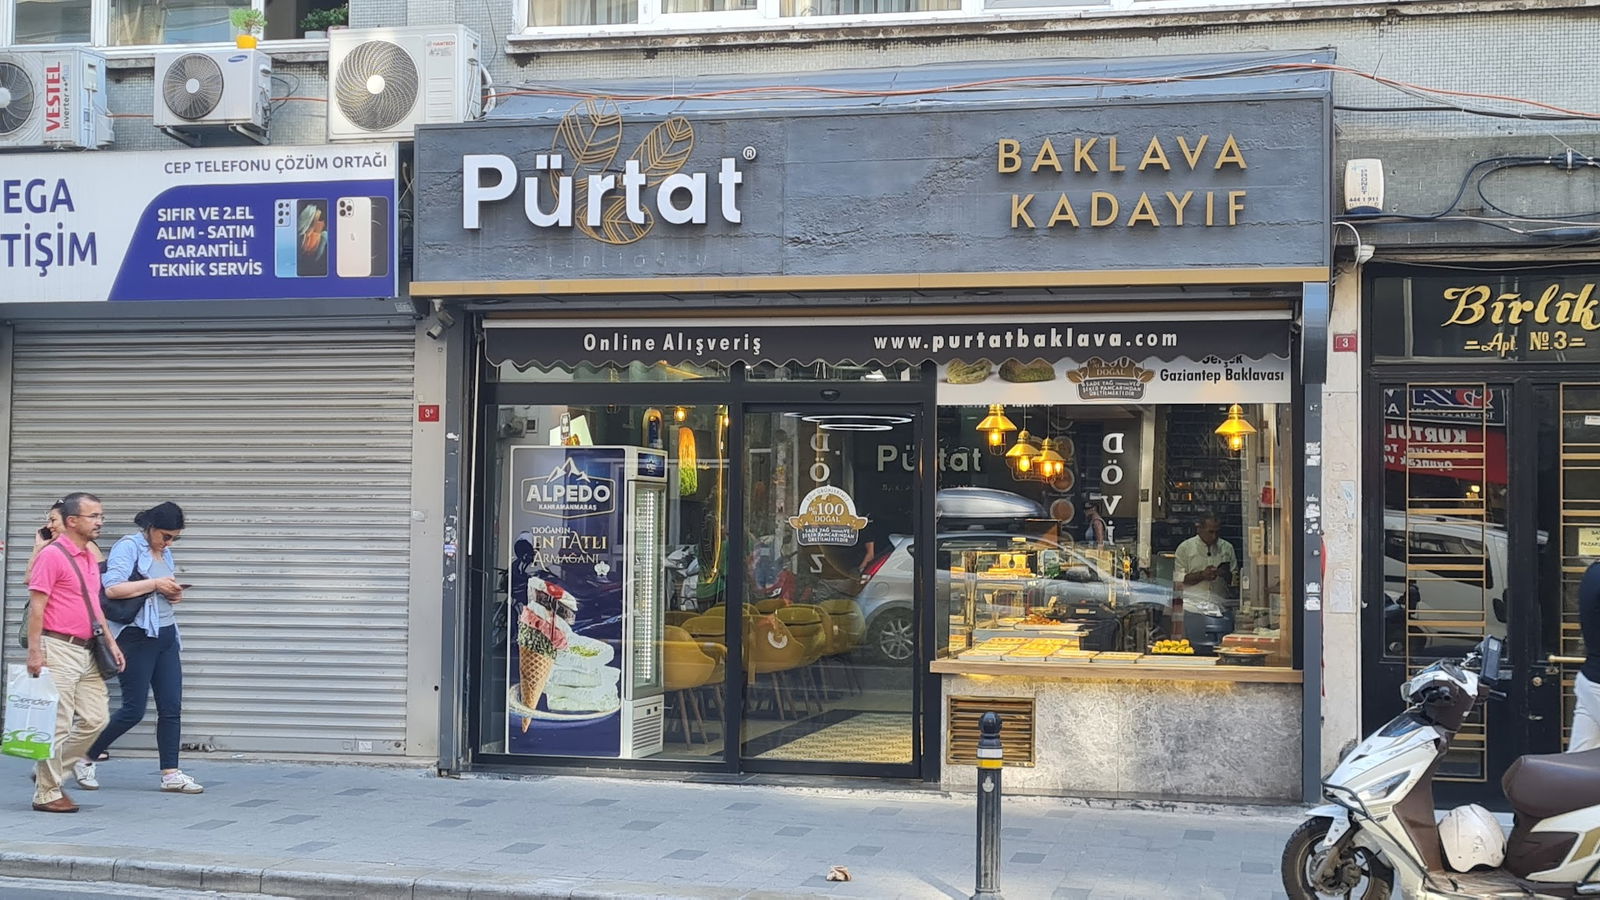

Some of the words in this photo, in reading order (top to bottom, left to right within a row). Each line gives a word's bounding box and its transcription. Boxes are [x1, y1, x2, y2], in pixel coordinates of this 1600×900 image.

[46, 62, 60, 132] VESTEL
[62, 94, 70, 130] inverter
[164, 161, 191, 174] CEP
[195, 159, 271, 173] TELEFONU
[275, 155, 328, 173] ÇÖZÜM
[332, 152, 388, 168] ORTAĞI
[998, 133, 1248, 174] BAKLAVA
[4, 178, 75, 214] EGA
[462, 154, 743, 230] Pürtat
[157, 208, 196, 222] SIFIR
[199, 207, 220, 221] VE
[223, 206, 254, 220] 2.EL
[1011, 190, 1247, 229] KADAYIF
[157, 226, 195, 240] ALIM
[207, 225, 255, 239] SATIM
[0, 222, 97, 277] TİŞİM
[164, 240, 248, 259] GARANTİLİ
[149, 259, 207, 277] TEKNİK
[209, 258, 263, 276] SERVİS
[583, 332, 655, 352] Online
[663, 332, 762, 357] Alışveriş
[874, 327, 1178, 351] www.purtatbaklava.com
[1342, 337, 1349, 348] 3
[1160, 368, 1221, 385] Gaziantep
[1226, 367, 1284, 381] Baklavası
[877, 444, 982, 472] Pütat
[526, 485, 610, 502] ALPEDO
[531, 525, 571, 535] DOĞANIN
[814, 515, 841, 523] DOĞAL
[532, 535, 555, 549] EN
[557, 531, 607, 554] TATLI
[531, 549, 600, 573] ARMAĞANI
